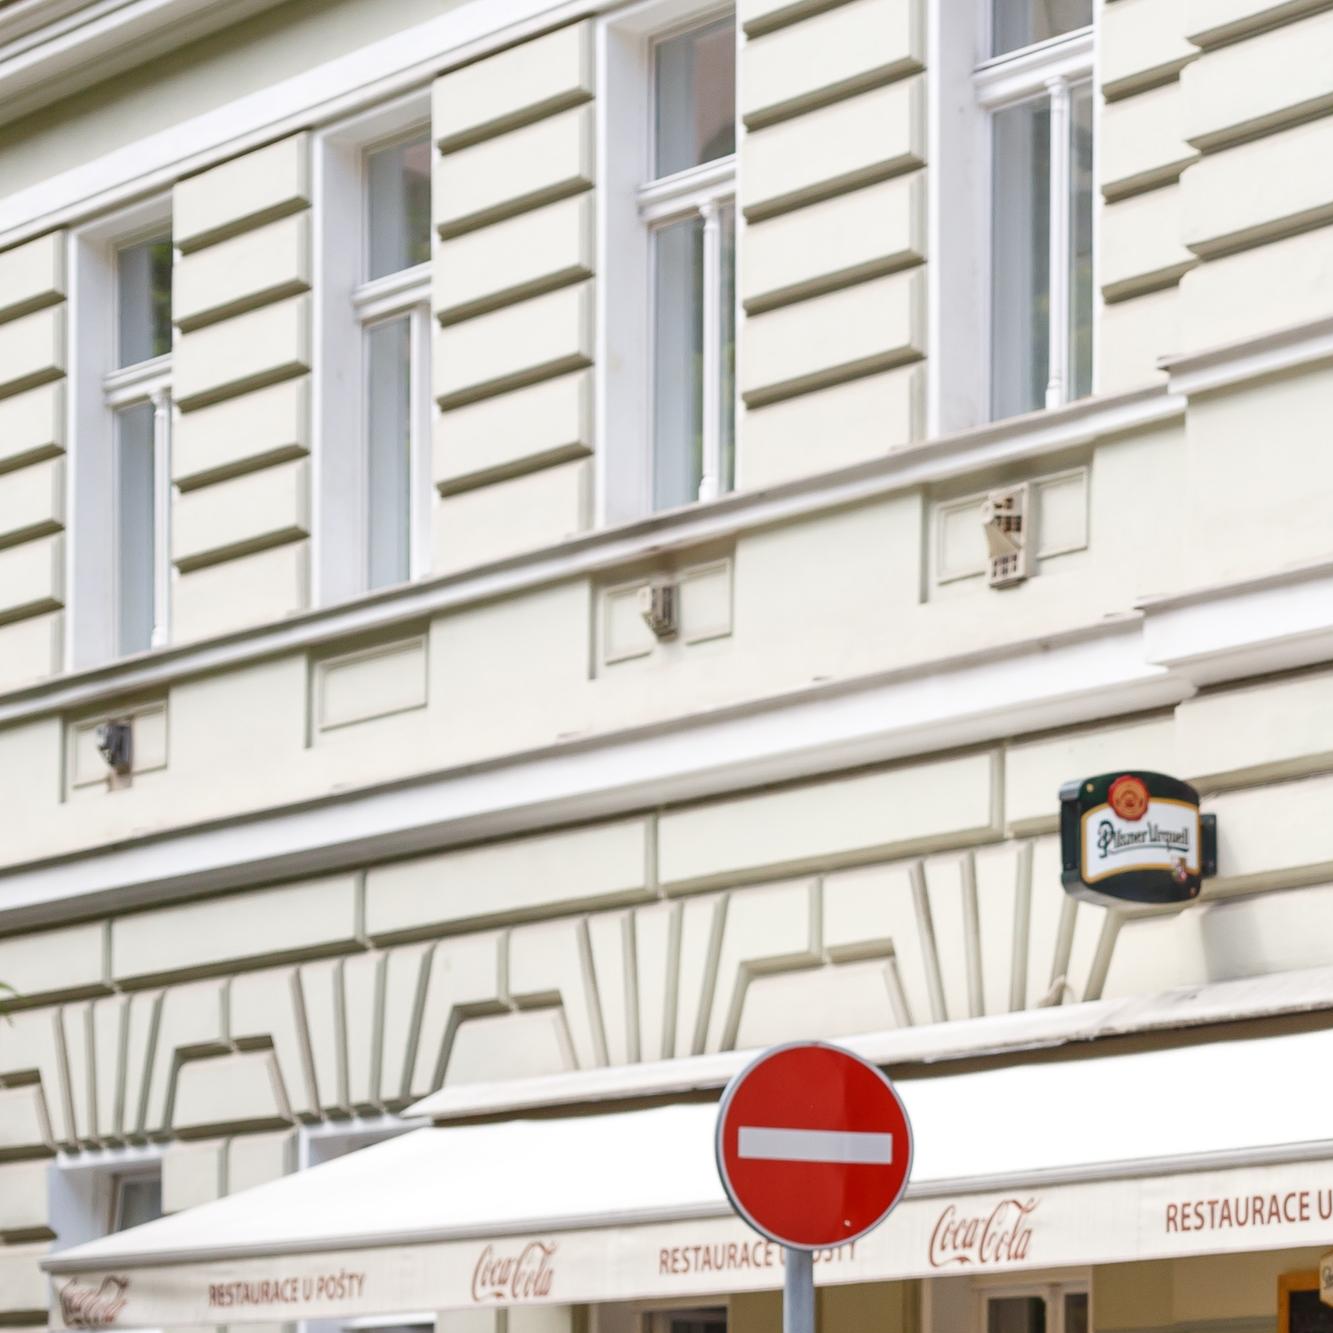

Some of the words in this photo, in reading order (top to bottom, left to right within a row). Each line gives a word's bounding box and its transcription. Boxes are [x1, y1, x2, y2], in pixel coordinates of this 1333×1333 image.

[1097, 820, 1148, 859] Pilsner
[1149, 822, 1190, 852] Urquell
[1165, 1190, 1311, 1233] RESTAURACE
[1317, 1188, 1333, 1220] U
[928, 1197, 1041, 1268] Coca-Cola
[471, 1240, 559, 1302] Coca-Cola
[658, 1239, 773, 1275] RESTAURACE
[208, 1279, 298, 1307] RESTAURACE
[302, 1281, 313, 1301] U
[317, 1267, 367, 1301] POŠTY
